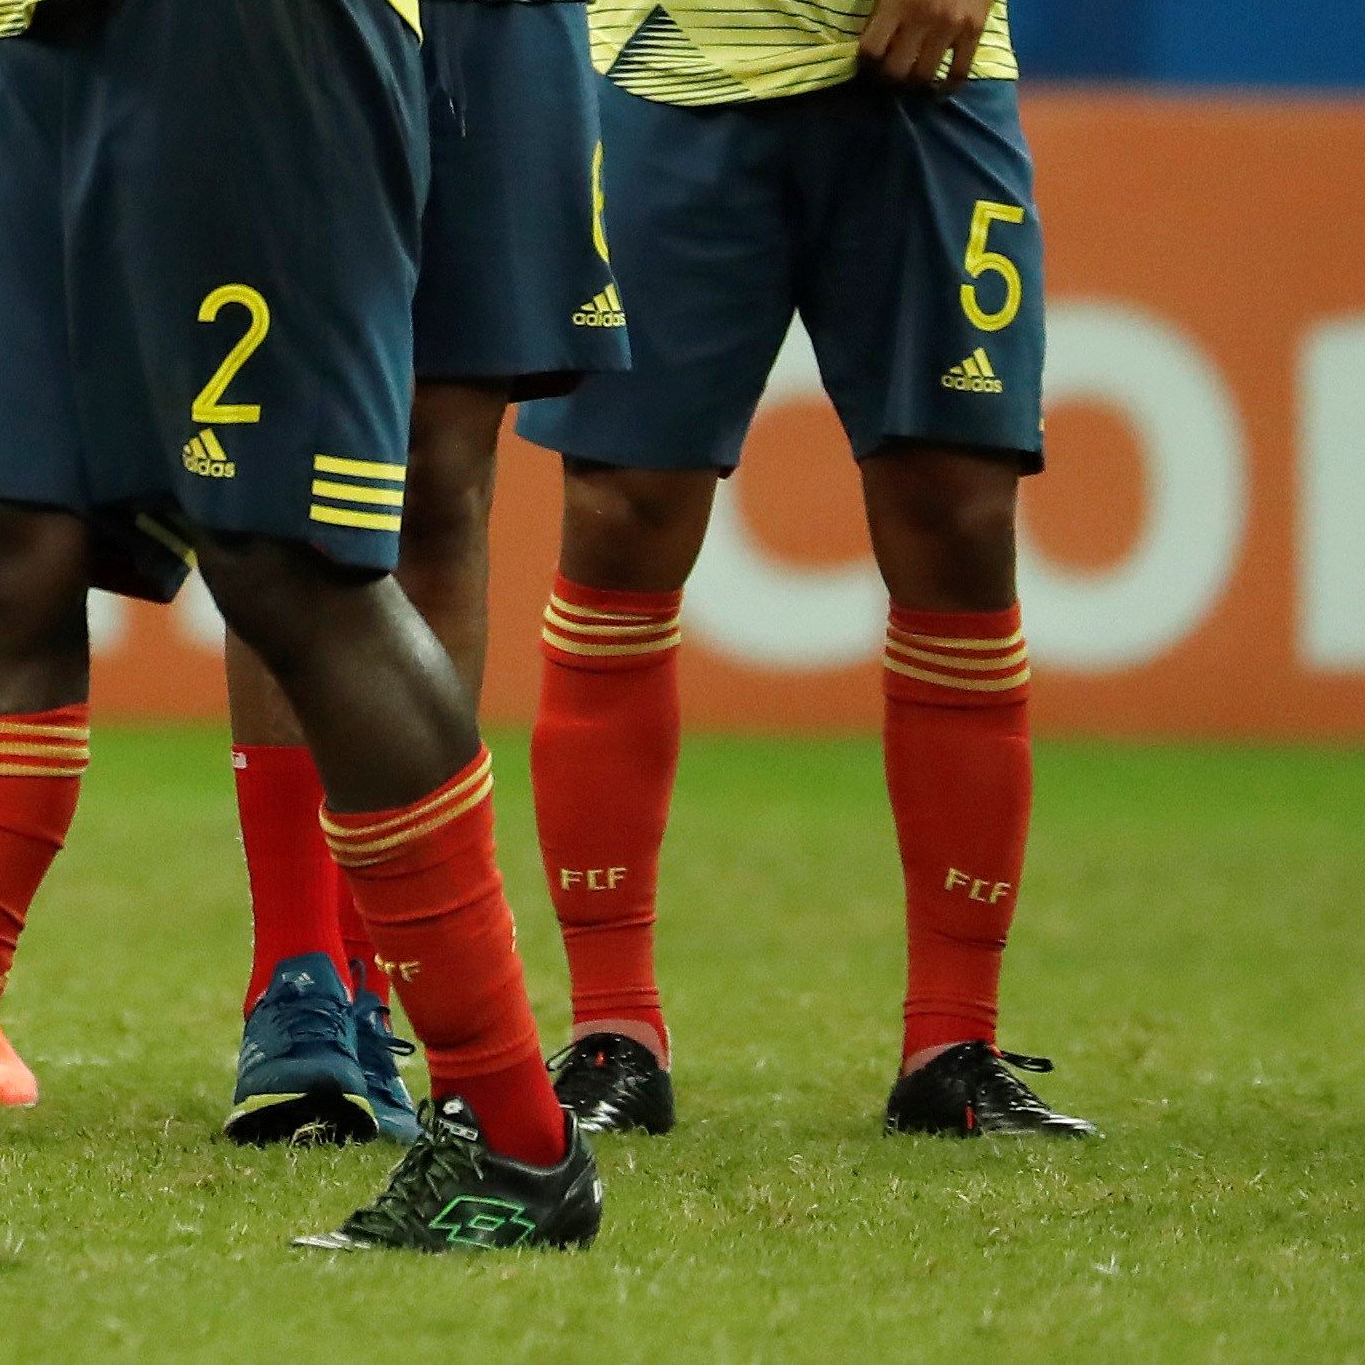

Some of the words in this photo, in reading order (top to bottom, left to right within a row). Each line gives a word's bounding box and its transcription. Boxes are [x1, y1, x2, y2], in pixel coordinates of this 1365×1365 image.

[960, 200, 1026, 332] 5
[192, 283, 270, 424] 2
[941, 375, 1004, 394] adidas
[560, 867, 627, 891] FCF
[944, 867, 1012, 904] FCF
